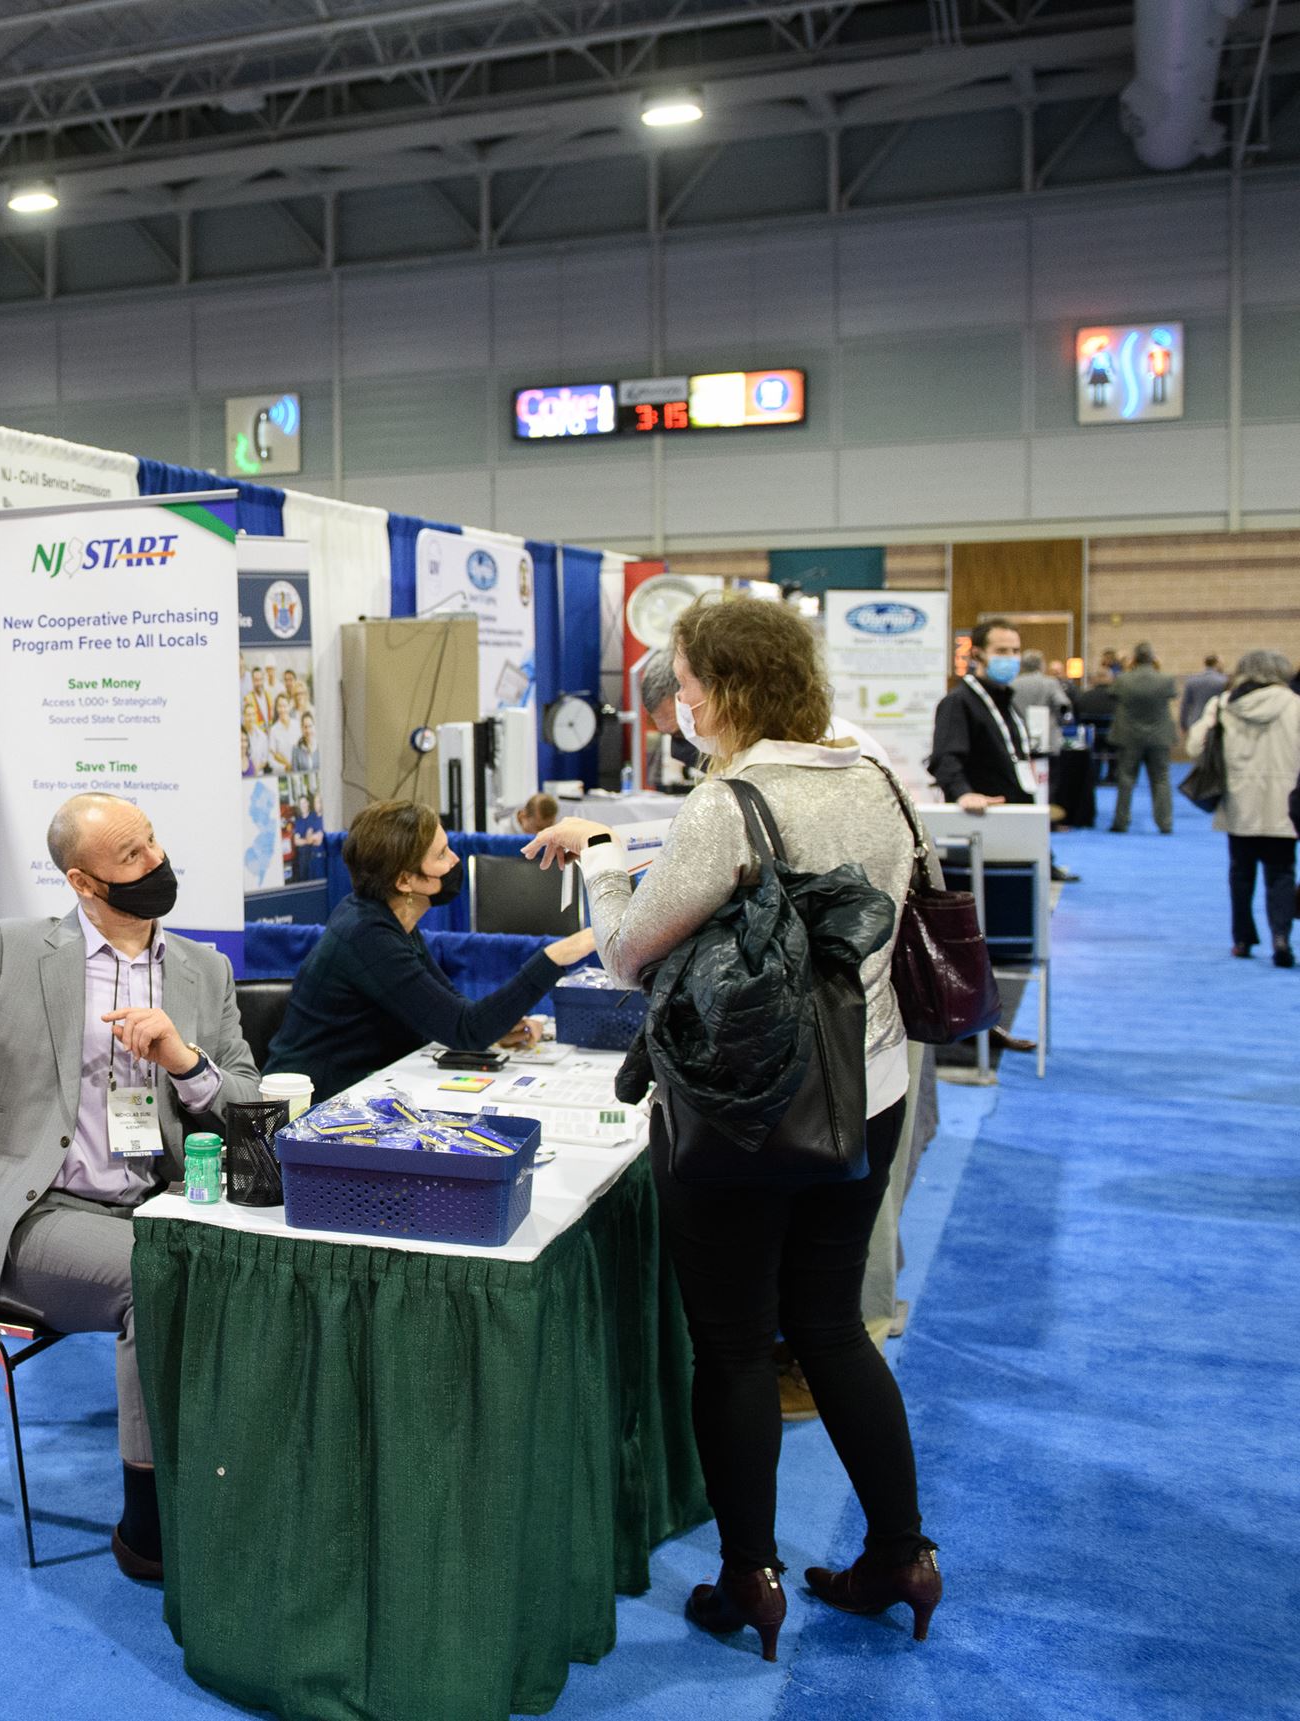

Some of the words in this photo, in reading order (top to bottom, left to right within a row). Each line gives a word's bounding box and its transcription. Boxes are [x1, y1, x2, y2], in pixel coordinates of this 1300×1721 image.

[516, 388, 599, 419] Coke
[1, 466, 11, 482] NJ
[19, 470, 38, 486] Civil
[41, 473, 69, 491] Service
[71, 478, 111, 498] Commission
[31, 542, 65, 578] NJ
[82, 534, 178, 570] START
[3, 616, 33, 630] New
[38, 612, 128, 631] Cooperative
[132, 608, 219, 625] Purchasing
[12, 638, 73, 655] Program
[78, 637, 112, 650] Free
[116, 636, 131, 649] to
[135, 634, 154, 648] All
[159, 632, 208, 648] Locals
[68, 679, 98, 690] Save
[101, 678, 141, 691] Money
[42, 698, 75, 707] Access
[78, 697, 109, 708] 1,000+
[112, 697, 167, 709] Strategically
[48, 715, 89, 724] Sourced
[91, 715, 115, 724] State
[117, 714, 161, 724] Contracts
[75, 761, 105, 773] Save
[109, 761, 138, 773] Time
[33, 780, 88, 791] Easy-to-use
[90, 780, 121, 790] Online
[123, 781, 179, 791] Marketplace
[31, 861, 43, 871] All
[36, 876, 66, 887] Jersey
